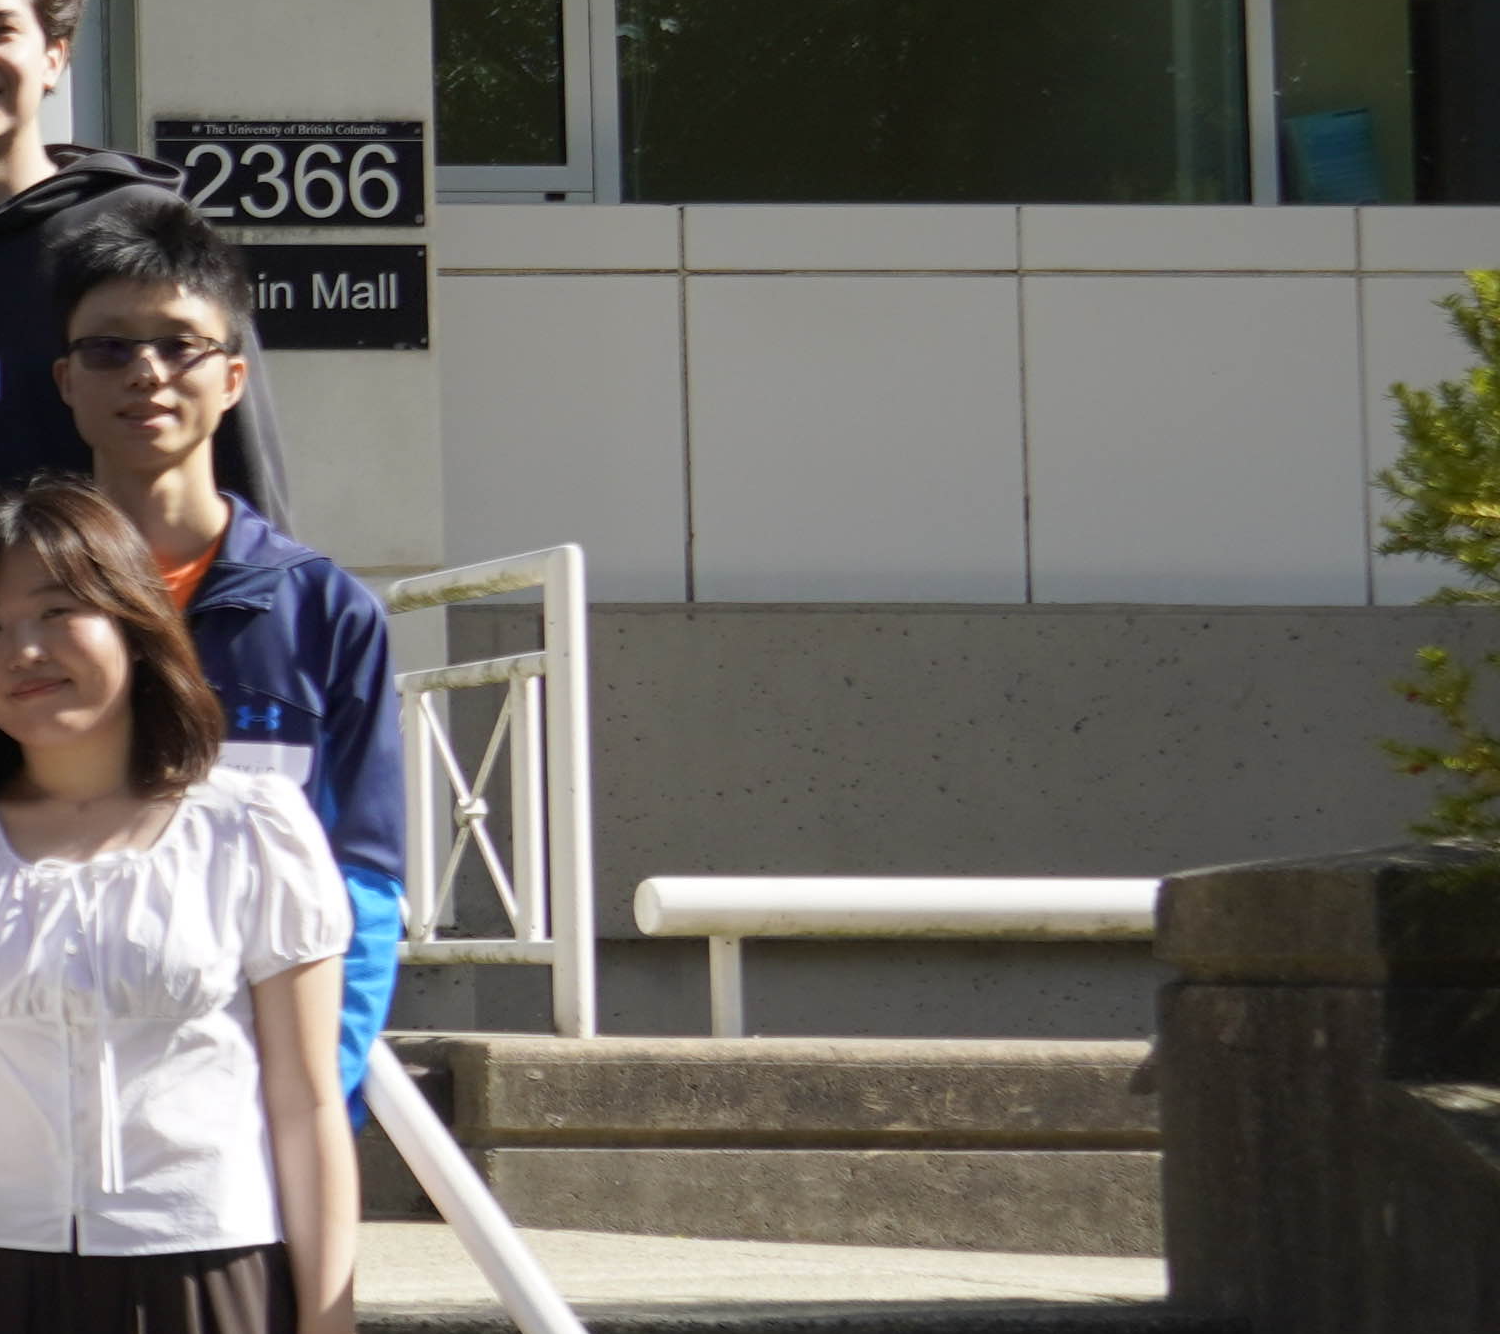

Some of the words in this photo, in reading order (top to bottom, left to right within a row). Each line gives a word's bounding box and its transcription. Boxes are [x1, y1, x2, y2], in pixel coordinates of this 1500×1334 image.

[204, 124, 225, 135] The
[228, 124, 282, 137] University
[283, 124, 295, 135] of
[298, 124, 333, 135] British
[335, 124, 387, 135] Columbia
[185, 144, 399, 218] 2366
[251, 273, 293, 310] in
[312, 273, 397, 310] Mall
